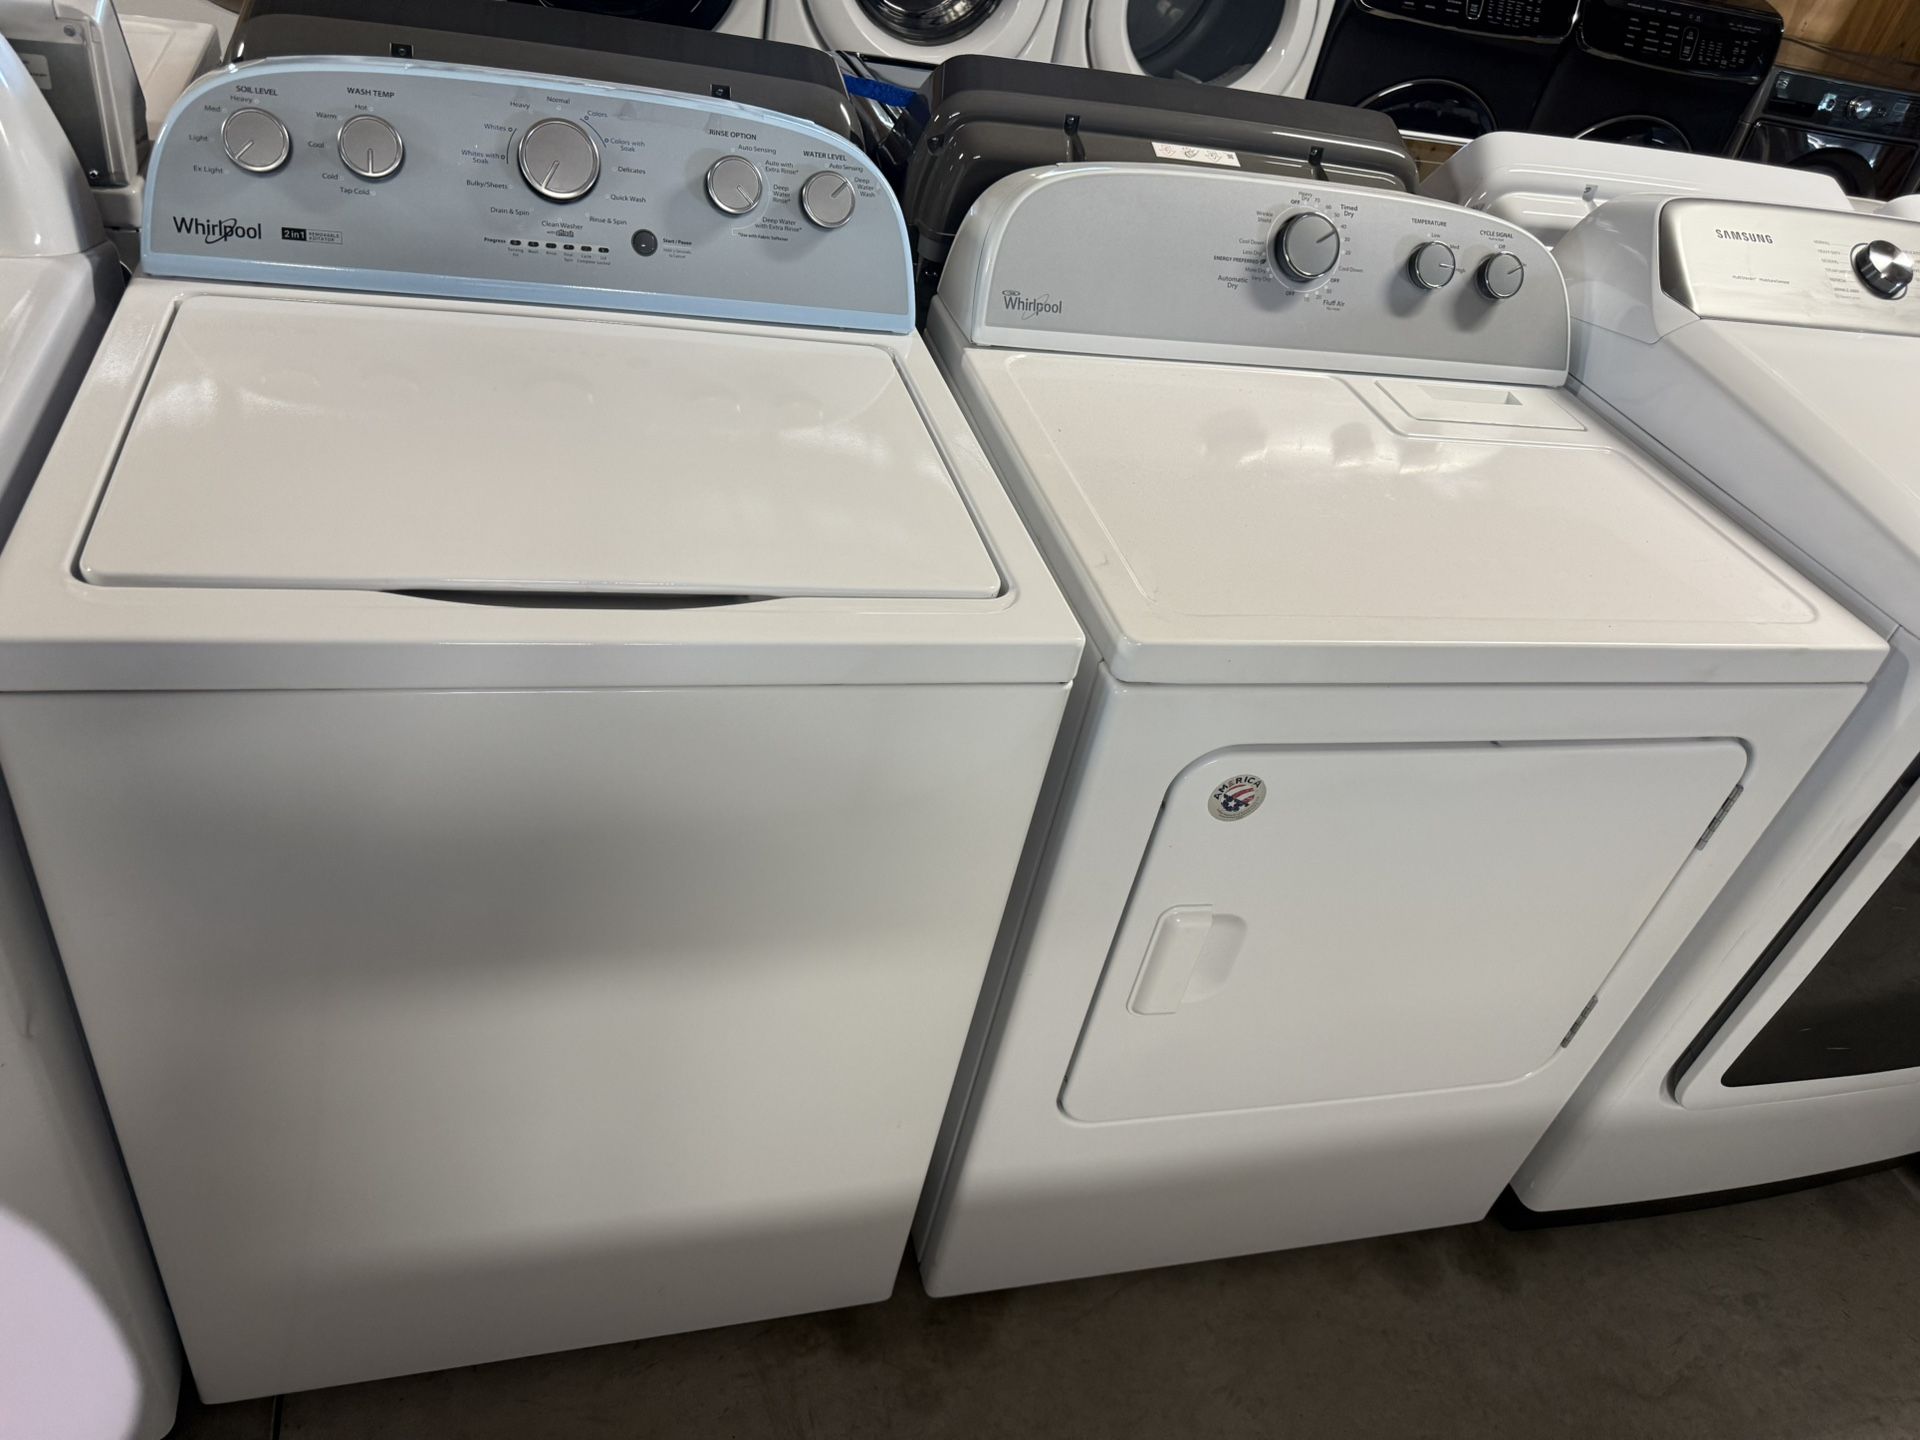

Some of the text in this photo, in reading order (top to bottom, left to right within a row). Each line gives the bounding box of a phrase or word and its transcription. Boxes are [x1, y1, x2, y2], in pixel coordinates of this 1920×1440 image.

[236, 85, 278, 96] SOIL LEVEL
[346, 87, 395, 98] WASH TEMP
[230, 95, 253, 103] Heavy
[546, 96, 570, 104] Normal
[510, 101, 531, 109] Heavy
[315, 111, 337, 119] Warm
[586, 110, 608, 118] Colors
[484, 123, 506, 131] Whites
[189, 134, 208, 142] Light
[709, 129, 757, 140] RINSE OPTION
[307, 140, 325, 149] Cool
[610, 137, 630, 146] Colors
[461, 149, 484, 158] Whites
[620, 145, 635, 153] Soak
[738, 144, 777, 155] Auto Sensing
[803, 150, 847, 161] WATER LEVEL
[203, 166, 223, 174] Light
[617, 166, 646, 175] Delicates
[842, 164, 864, 173] Sensing
[321, 172, 339, 180] Cold
[466, 179, 508, 189] Bulky/Sheets
[490, 206, 508, 214] Drain
[1340, 203, 1359, 211] Timed
[1343, 210, 1354, 219] Dry
[612, 218, 627, 226] Spin
[762, 216, 779, 224] Deep
[1411, 217, 1447, 227] TEMPERATURE
[173, 216, 262, 243] Whirlpool
[541, 220, 583, 230] Clean Washer
[1479, 229, 1513, 239] CYCLE SIGNAL
[1715, 229, 1773, 244] SAMSUNG
[483, 236, 506, 244] Progress
[1217, 275, 1248, 283] Automatic
[1227, 282, 1239, 290] Dry
[1003, 295, 1062, 316] Whirlpool
